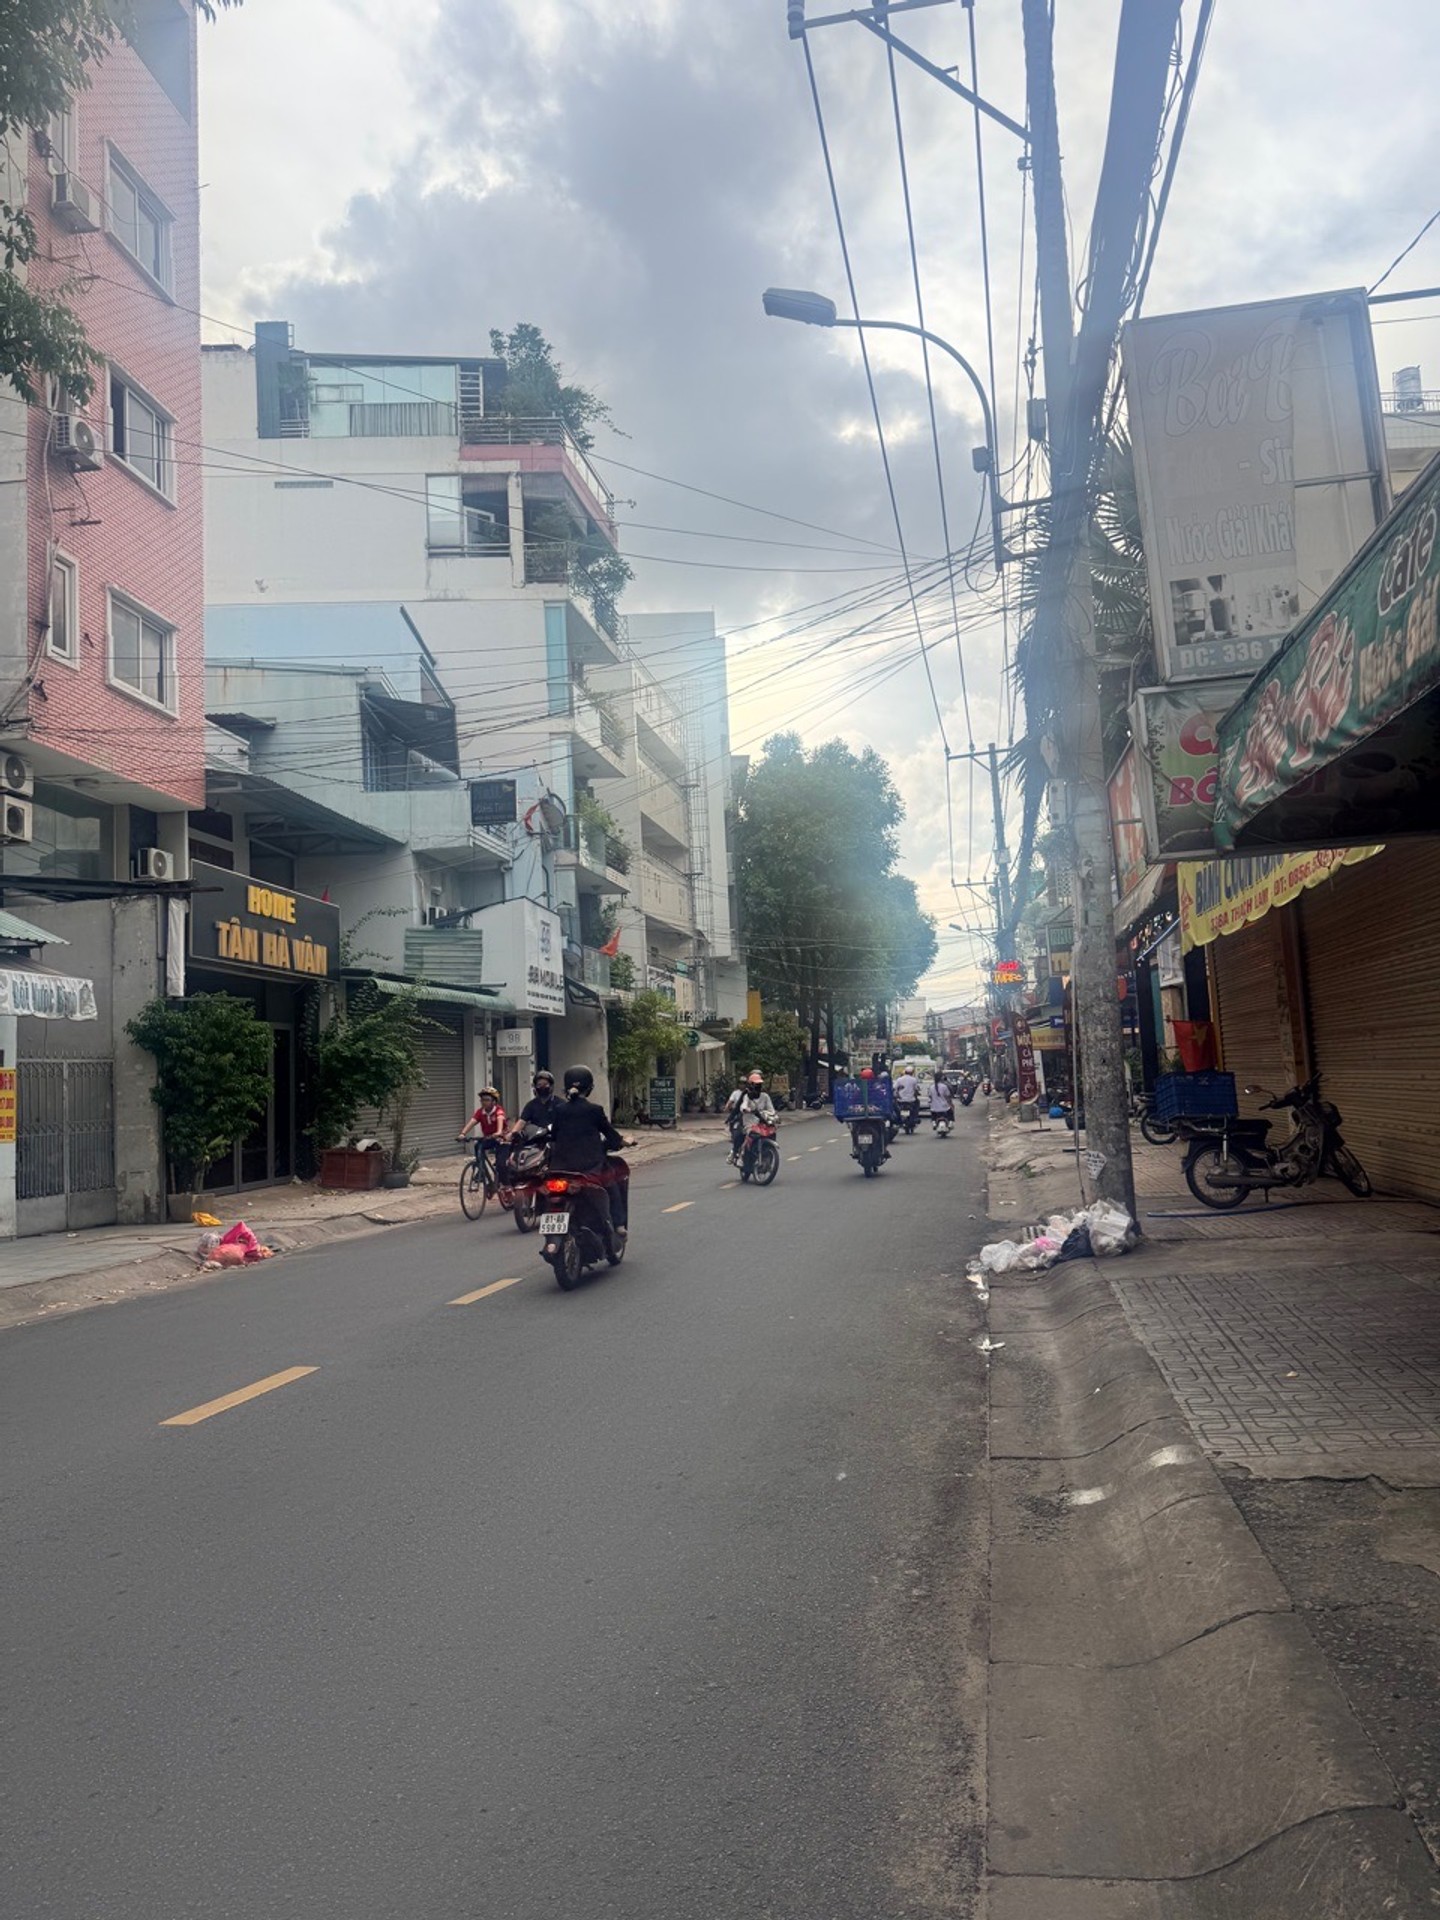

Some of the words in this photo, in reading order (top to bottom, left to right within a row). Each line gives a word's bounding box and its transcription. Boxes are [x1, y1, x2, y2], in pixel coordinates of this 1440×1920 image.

[1214, 503, 1252, 560] Giải
[1222, 640, 1264, 663] 336
[247, 884, 297, 924] HOME
[1254, 888, 1270, 909] LAM
[216, 916, 259, 963] TÂN
[292, 934, 328, 976] VÂN
